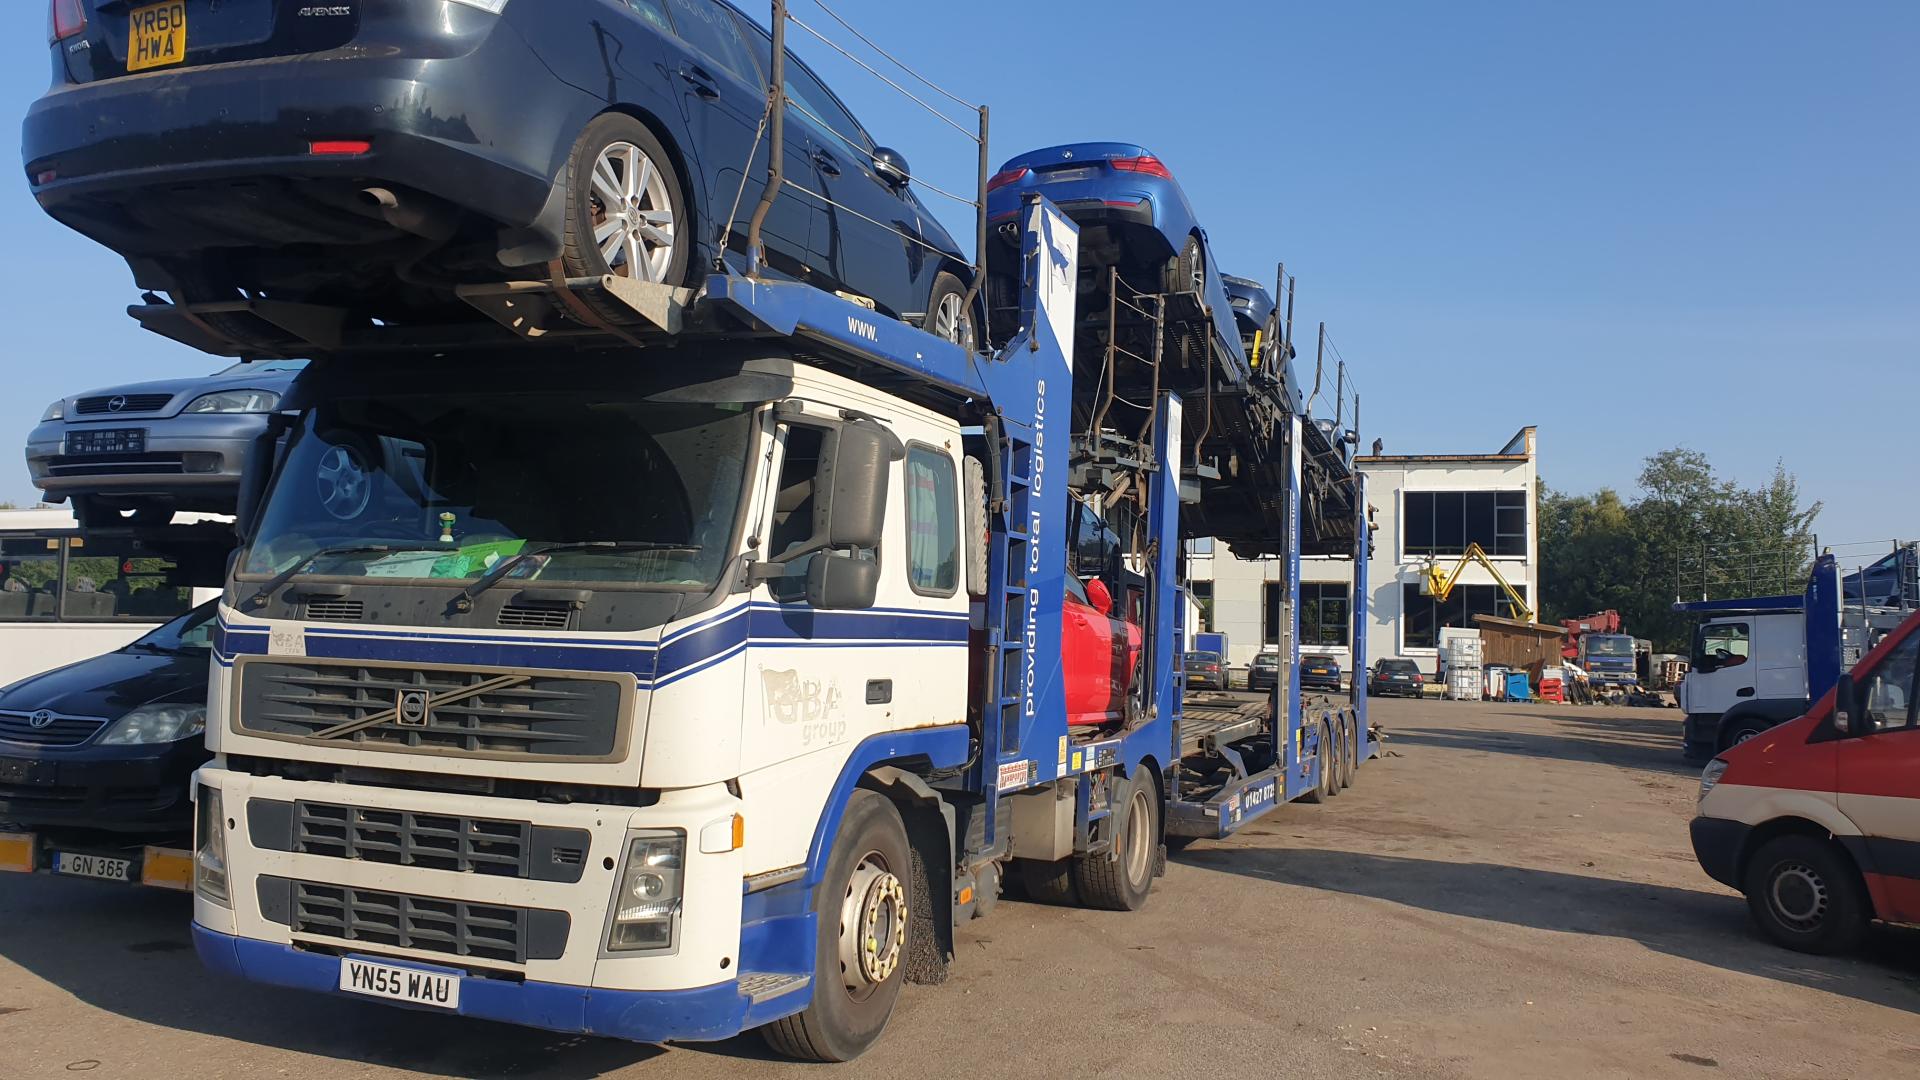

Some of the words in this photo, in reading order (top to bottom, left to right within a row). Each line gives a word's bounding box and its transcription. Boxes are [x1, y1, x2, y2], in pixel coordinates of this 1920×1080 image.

[133, 4, 183, 35] YR60
[136, 33, 175, 62] HWA
[1031, 379, 1046, 498] logistics
[1029, 511, 1041, 574] total
[1025, 588, 1039, 717] providing
[802, 720, 847, 746] group
[72, 856, 93, 874] GN
[97, 859, 124, 878] 365
[350, 963, 401, 995] YN55
[408, 973, 449, 1002] WAU
